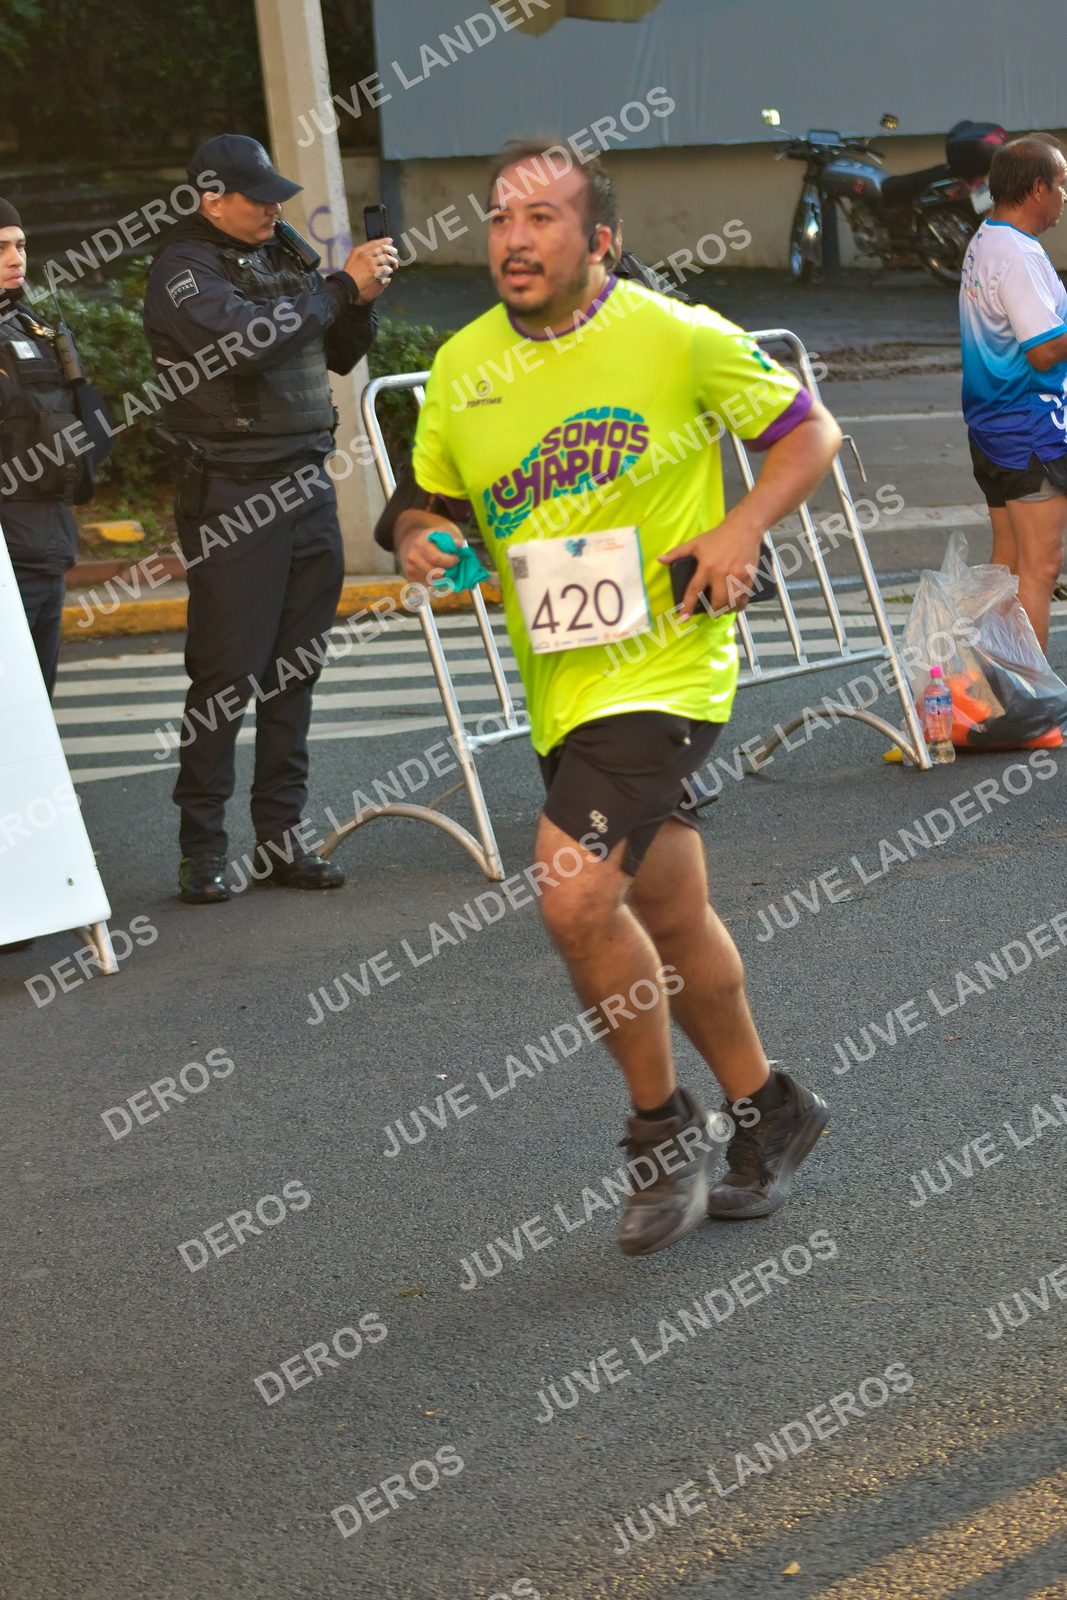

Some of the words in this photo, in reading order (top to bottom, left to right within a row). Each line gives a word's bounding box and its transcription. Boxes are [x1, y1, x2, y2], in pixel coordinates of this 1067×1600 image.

[540, 421, 649, 456] SOMOS
[491, 449, 621, 509] CHAPU
[531, 579, 623, 634] 420
